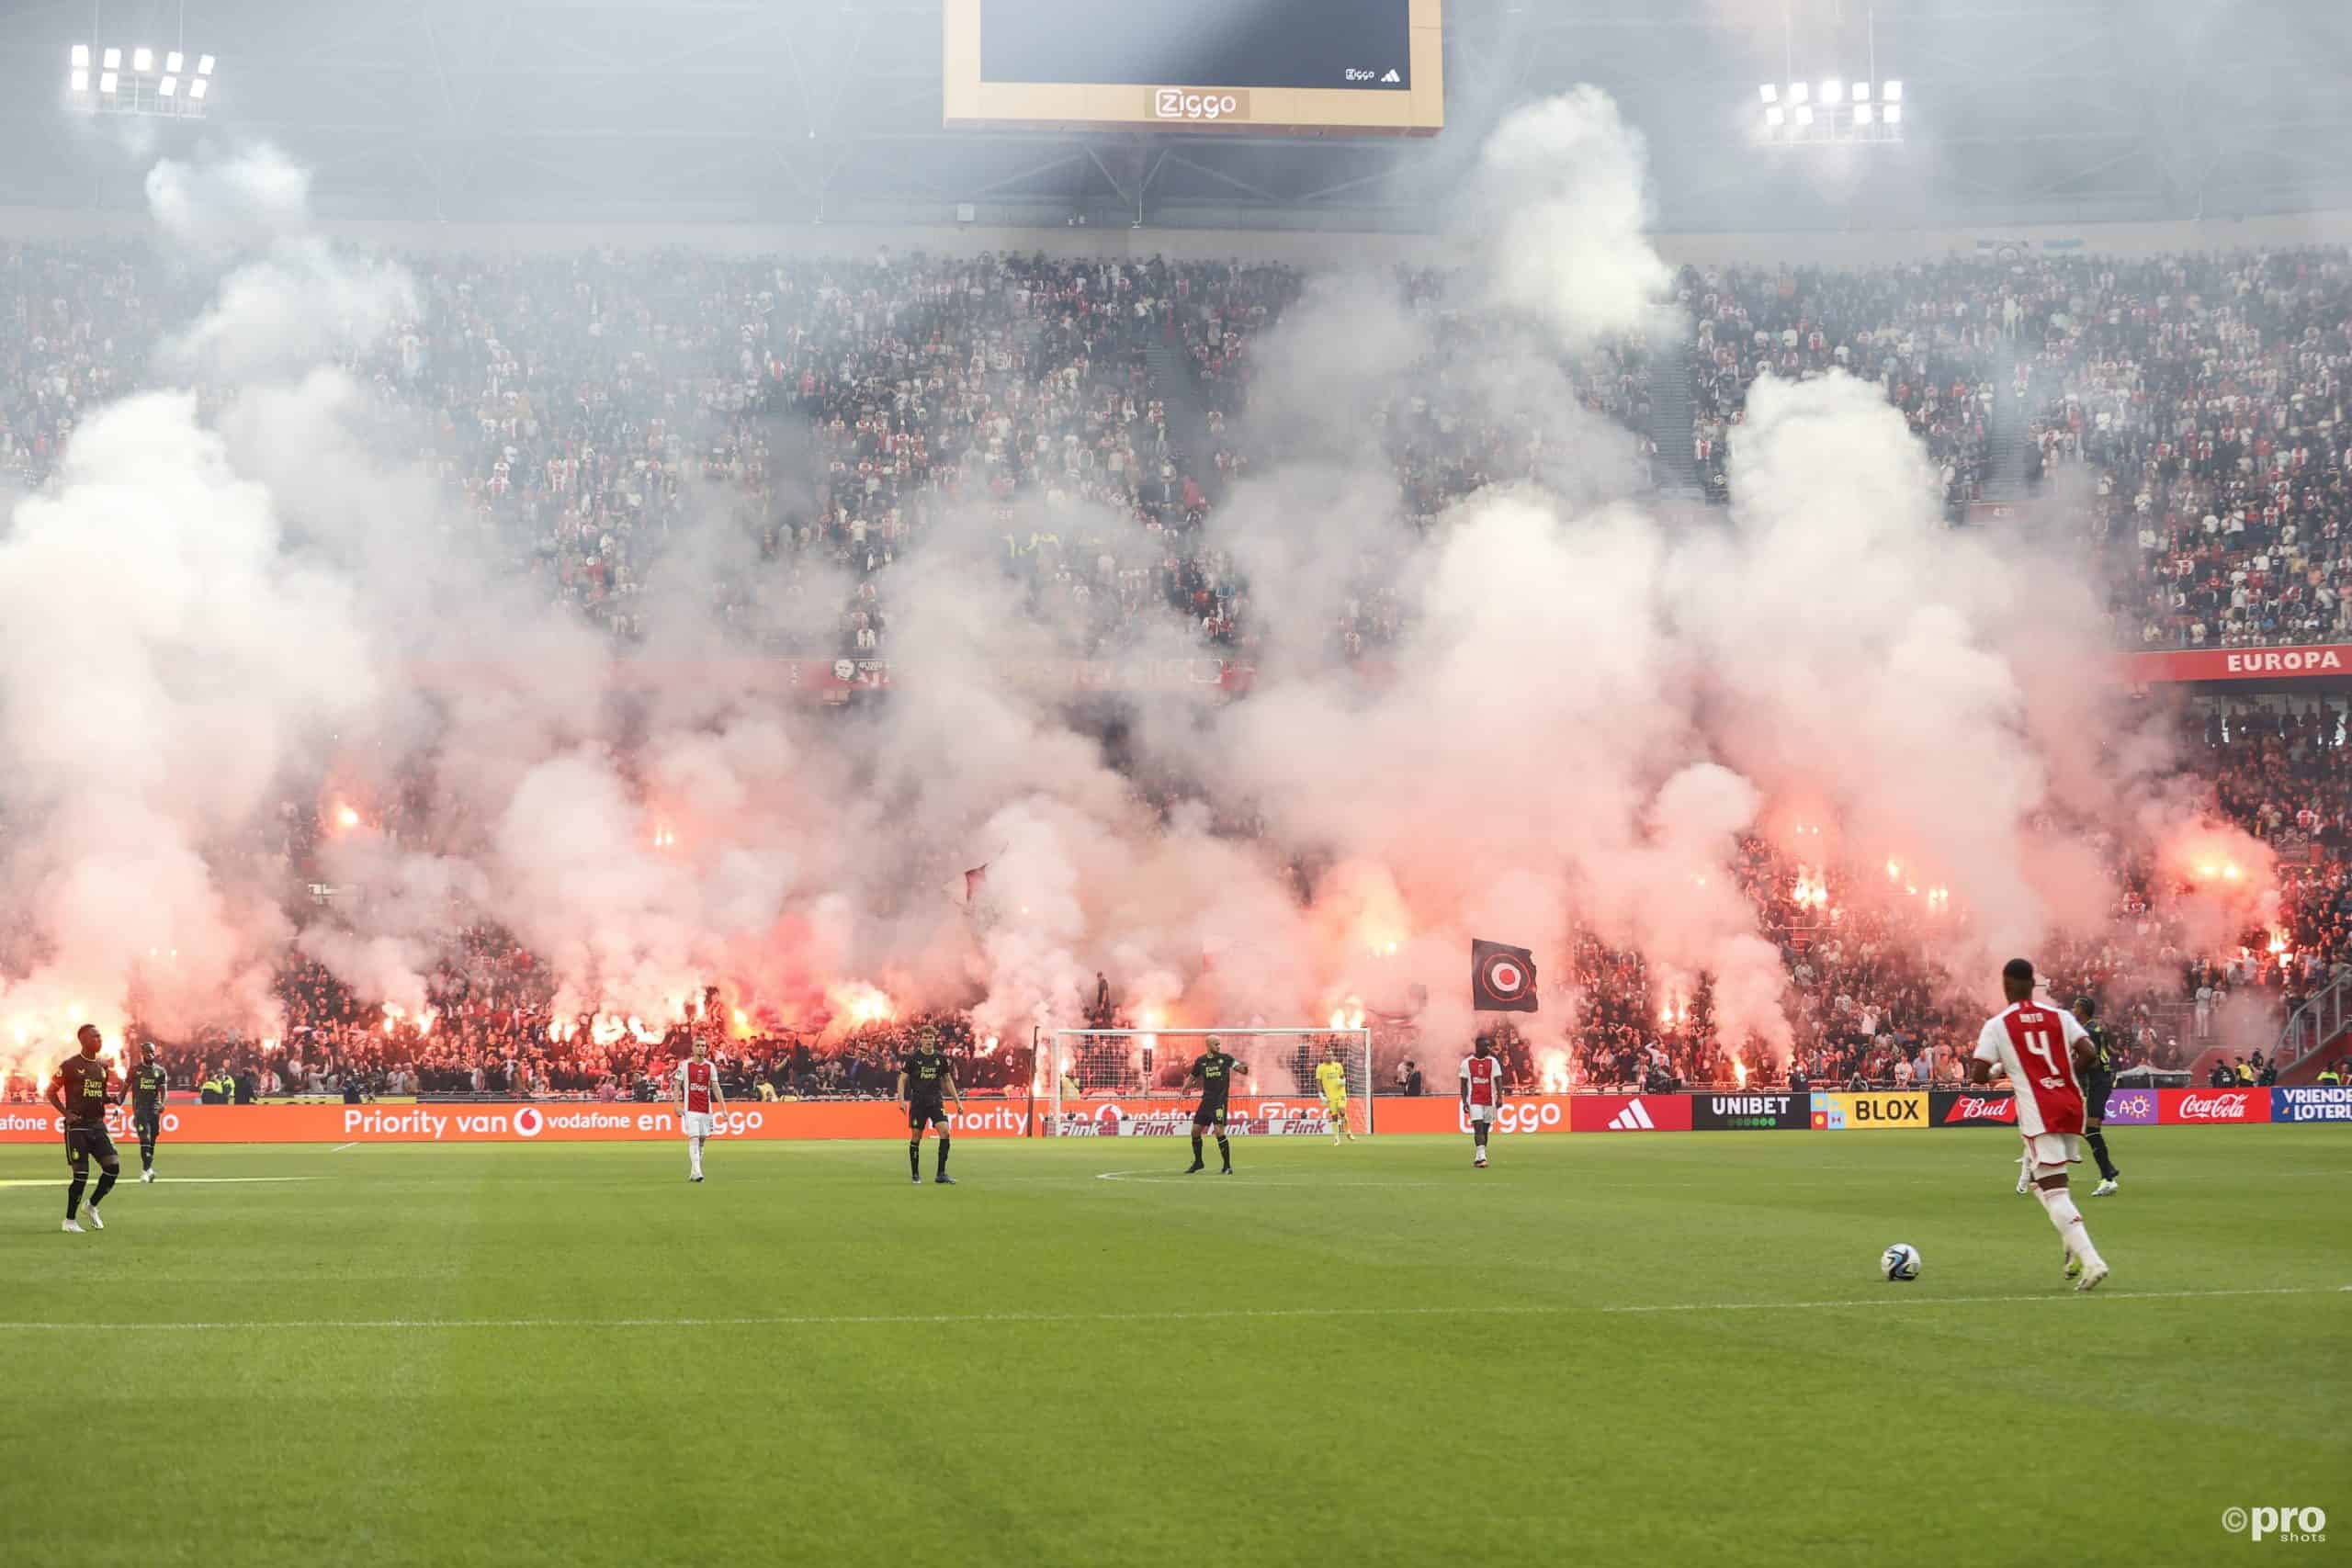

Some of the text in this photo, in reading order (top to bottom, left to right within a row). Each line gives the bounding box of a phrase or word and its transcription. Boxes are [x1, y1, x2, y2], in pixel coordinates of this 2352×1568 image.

[1155, 88, 1236, 118] Ziggo
[2227, 650, 2342, 672] EUROPA
[2024, 1030, 2061, 1076] 4
[84, 1079, 103, 1089] Euro
[1712, 1097, 1791, 1115] UNIBET
[1855, 1100, 1919, 1121] BLOX
[1959, 1097, 2008, 1118] Bud
[2294, 1104, 2352, 1121] LOTERI
[345, 1110, 447, 1139] Priority
[456, 1115, 507, 1133] van
[548, 1111, 631, 1129] vodafone
[638, 1113, 672, 1132] en
[928, 1107, 1029, 1135] riority
[1060, 1122, 1102, 1136] Flink
[1133, 1122, 1177, 1136] Flink
[1282, 1120, 1327, 1134] Flink
